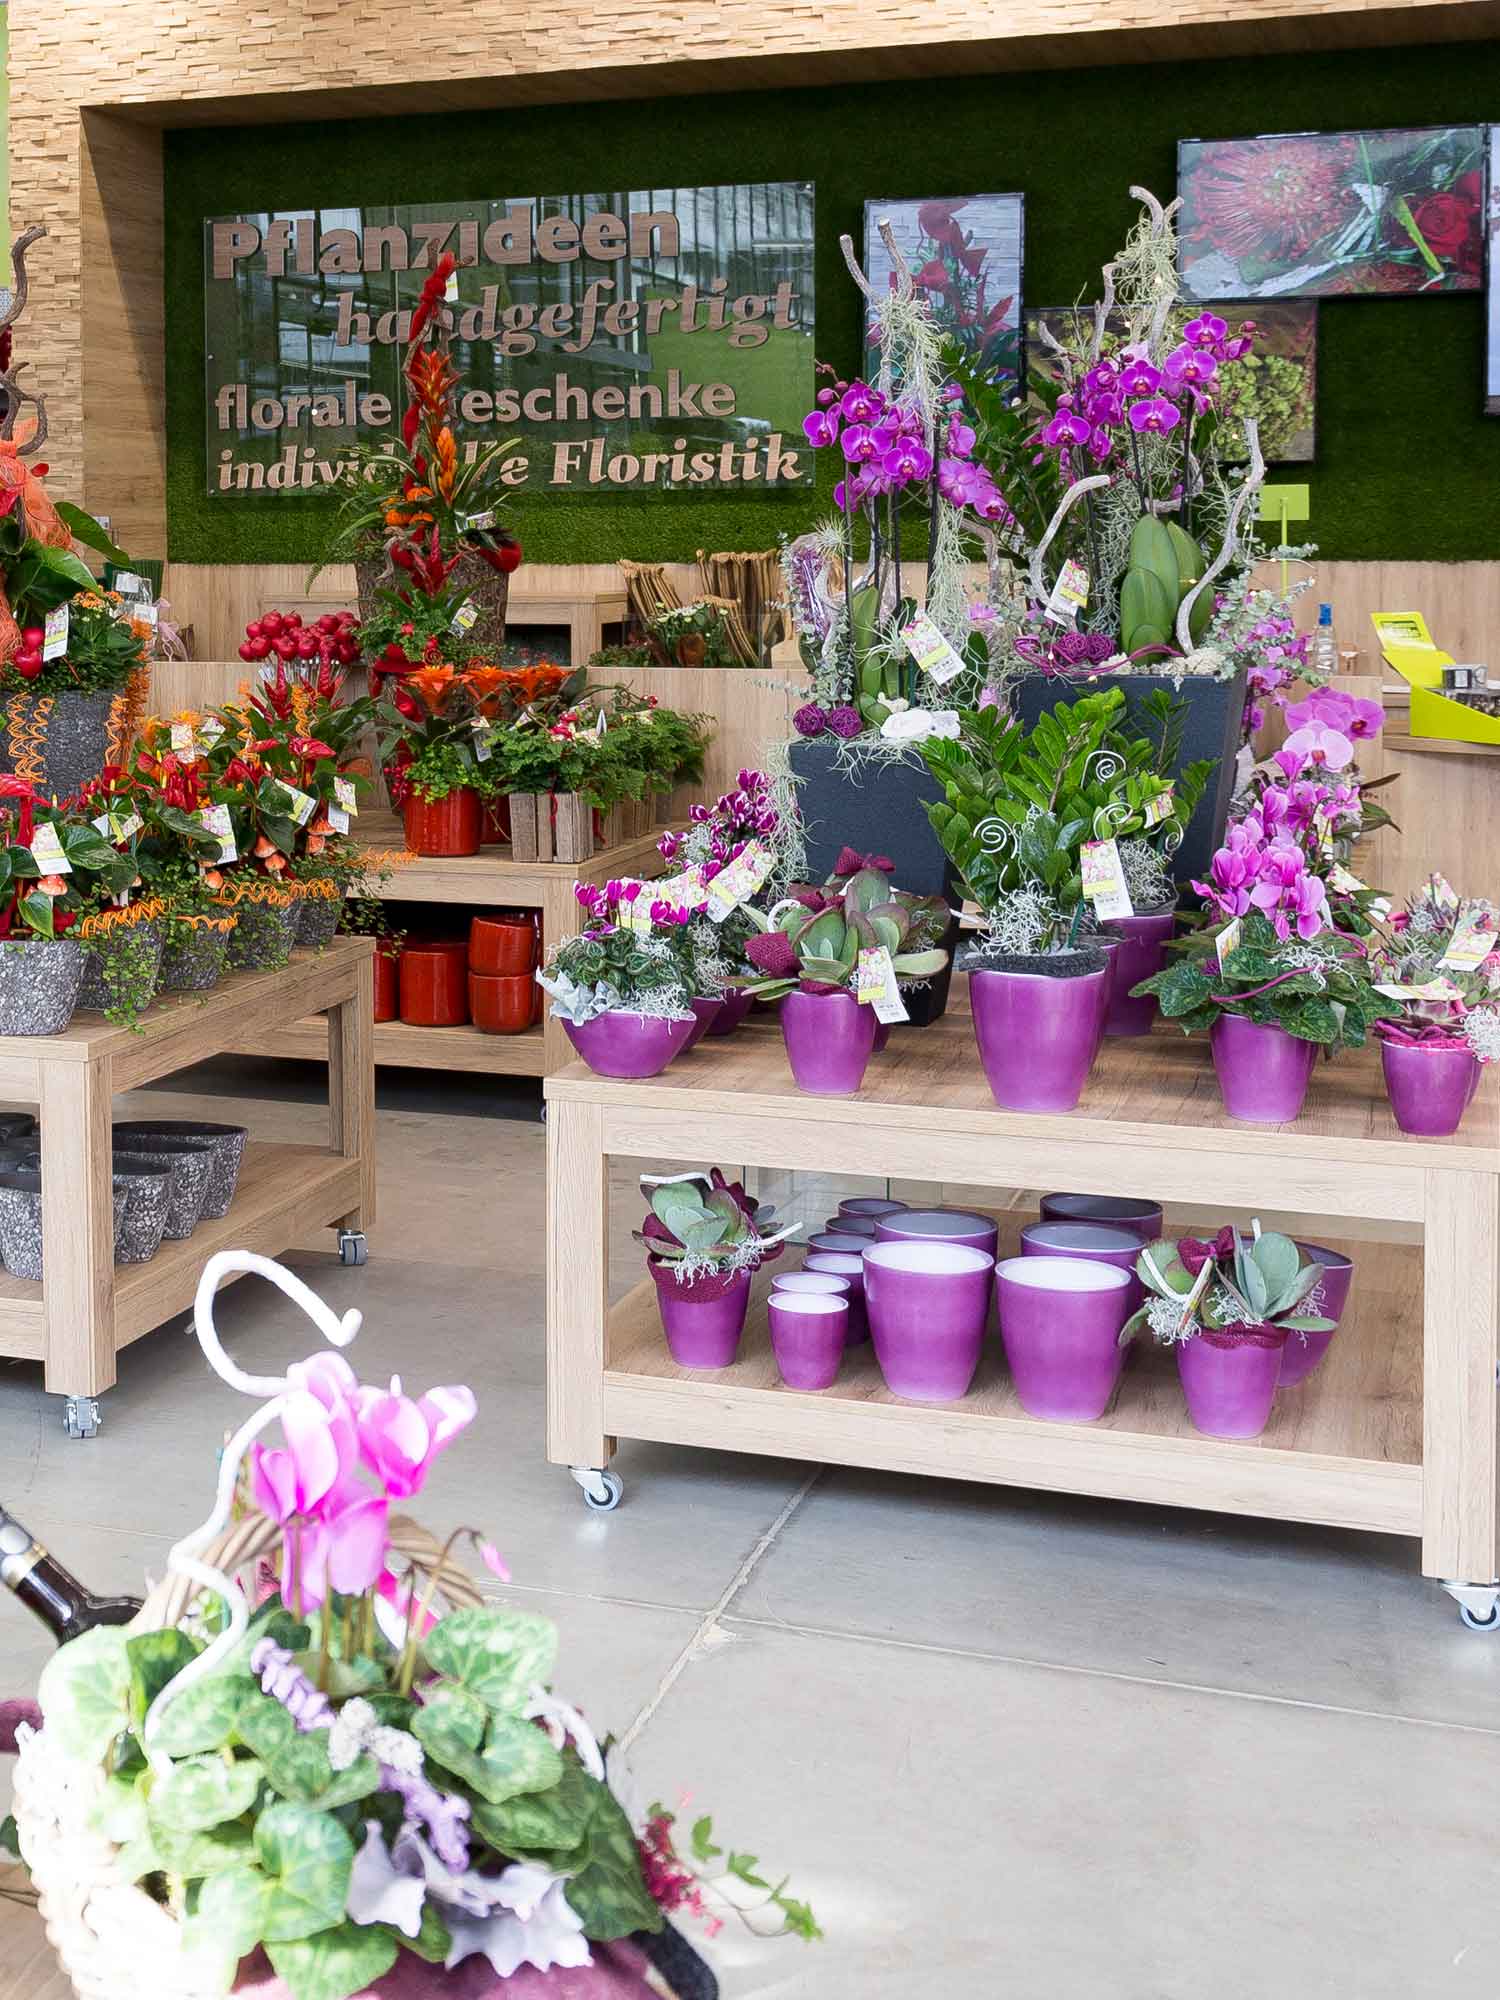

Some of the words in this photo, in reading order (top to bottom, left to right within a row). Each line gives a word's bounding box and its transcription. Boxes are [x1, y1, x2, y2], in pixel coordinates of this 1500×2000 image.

[215, 380, 392, 430] florale
[420, 369, 737, 425] eschenke
[217, 437, 529, 490] indivile
[551, 434, 804, 486] Floristik
